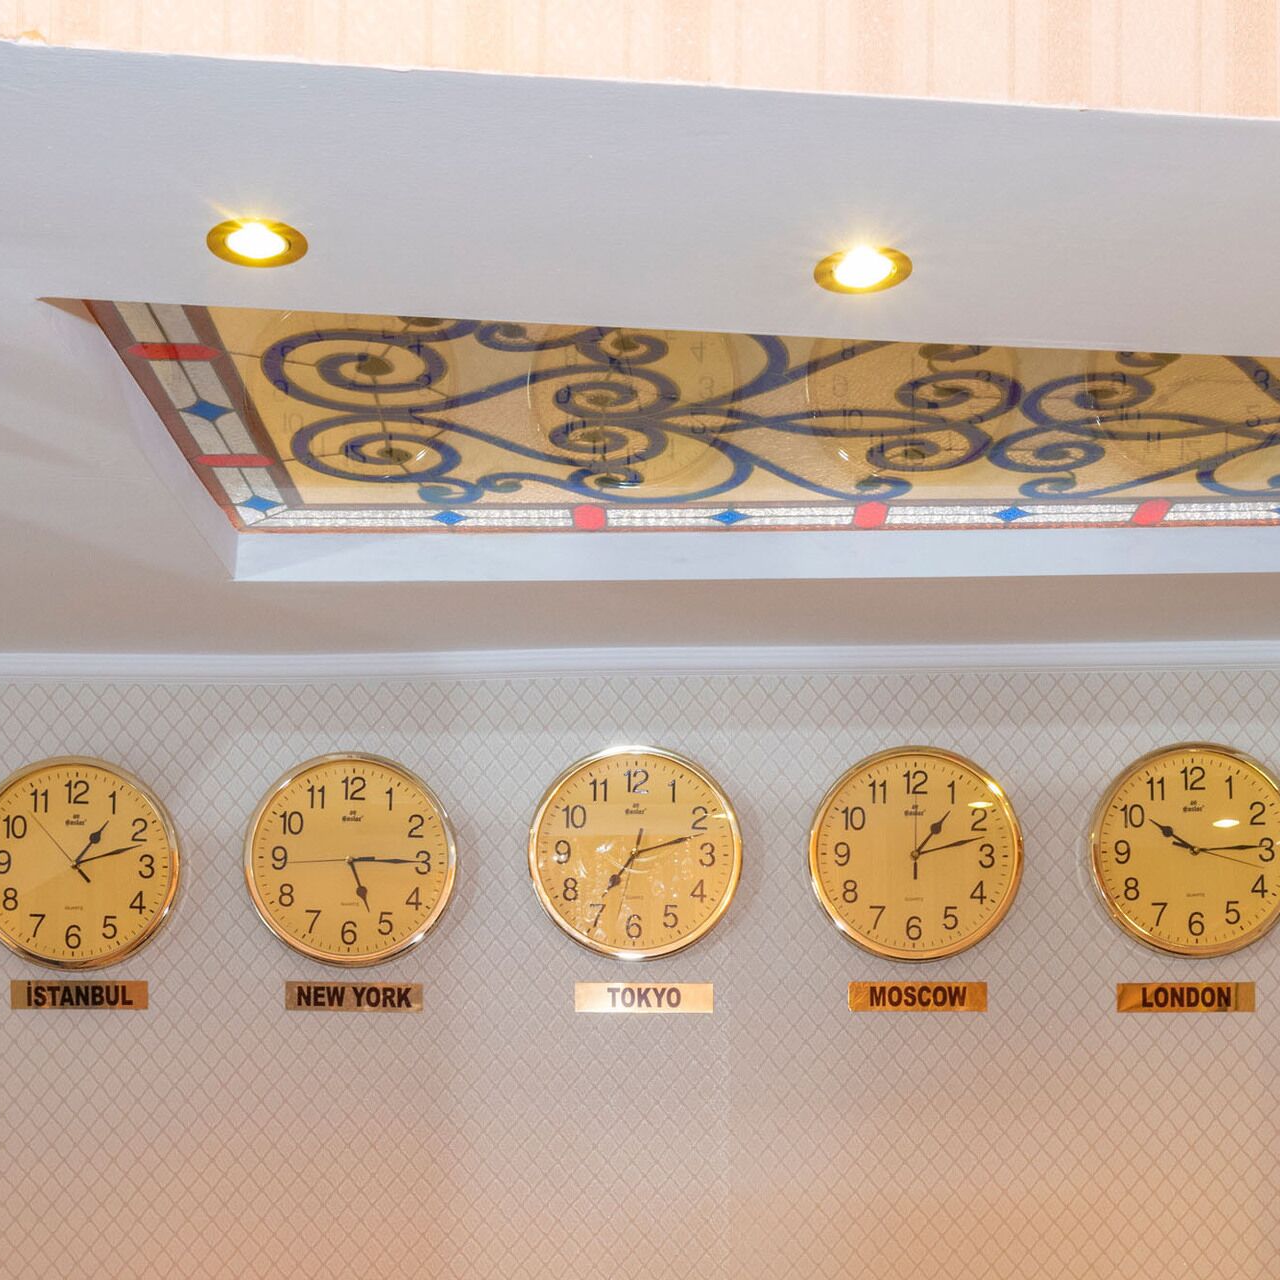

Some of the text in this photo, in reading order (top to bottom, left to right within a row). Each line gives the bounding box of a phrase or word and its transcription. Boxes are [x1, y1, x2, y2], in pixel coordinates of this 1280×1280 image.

[342, 777, 366, 800] 12
[624, 769, 649, 794] 12
[903, 771, 928, 794] 12
[1147, 777, 1165, 800] 11
[1180, 766, 1206, 790] 12
[1225, 776, 1233, 799] 1
[30, 789, 48, 812] 11
[65, 780, 89, 804] 12
[307, 785, 325, 809] 11
[386, 787, 392, 810] 1
[590, 779, 607, 802] 11
[668, 779, 676, 803] 1
[869, 780, 886, 804] 11
[948, 780, 955, 804] 1
[109, 791, 116, 814] 1
[1249, 802, 1265, 825] 2
[3, 815, 27, 838] 10
[280, 811, 303, 835] 10
[408, 814, 424, 838] 2
[563, 805, 586, 828] 10
[692, 807, 707, 830] 2
[842, 807, 865, 830] 10
[972, 808, 987, 831] 2
[1120, 804, 1144, 828] 10
[132, 818, 147, 842] 2
[272, 846, 287, 870] 9
[699, 843, 715, 866] 3
[834, 842, 850, 866] 9
[979, 844, 995, 868] 3
[1115, 840, 1130, 864] 9
[1259, 838, 1275, 862] 3
[139, 854, 154, 878] 3
[415, 850, 431, 874] 3
[279, 884, 294, 906] 8
[563, 878, 578, 901] 8
[690, 880, 706, 903] 4
[843, 880, 858, 903] 8
[970, 881, 986, 904] 4
[1124, 877, 1139, 900] 8
[1251, 875, 1268, 898] 4
[3, 888, 18, 910] 8
[129, 891, 146, 914] 4
[406, 887, 422, 910] 4
[305, 910, 321, 933] 7
[378, 912, 393, 935] 5
[663, 905, 678, 928] 5
[869, 906, 886, 929] 7
[943, 906, 958, 929] 5
[1151, 902, 1168, 926] 7
[1188, 912, 1204, 936] 6
[1225, 901, 1240, 924] 5
[29, 914, 45, 937] 7
[65, 925, 81, 948] 6
[102, 916, 117, 939] 5
[342, 921, 357, 945] 6
[626, 914, 641, 939] 6
[906, 916, 922, 940] 6
[27, 982, 133, 1006] İSTANBUL
[297, 985, 412, 1007] NEW YORK
[607, 987, 681, 1007] TOKYO
[870, 985, 966, 1006] MOSCOW
[1142, 987, 1231, 1007] LONDON
